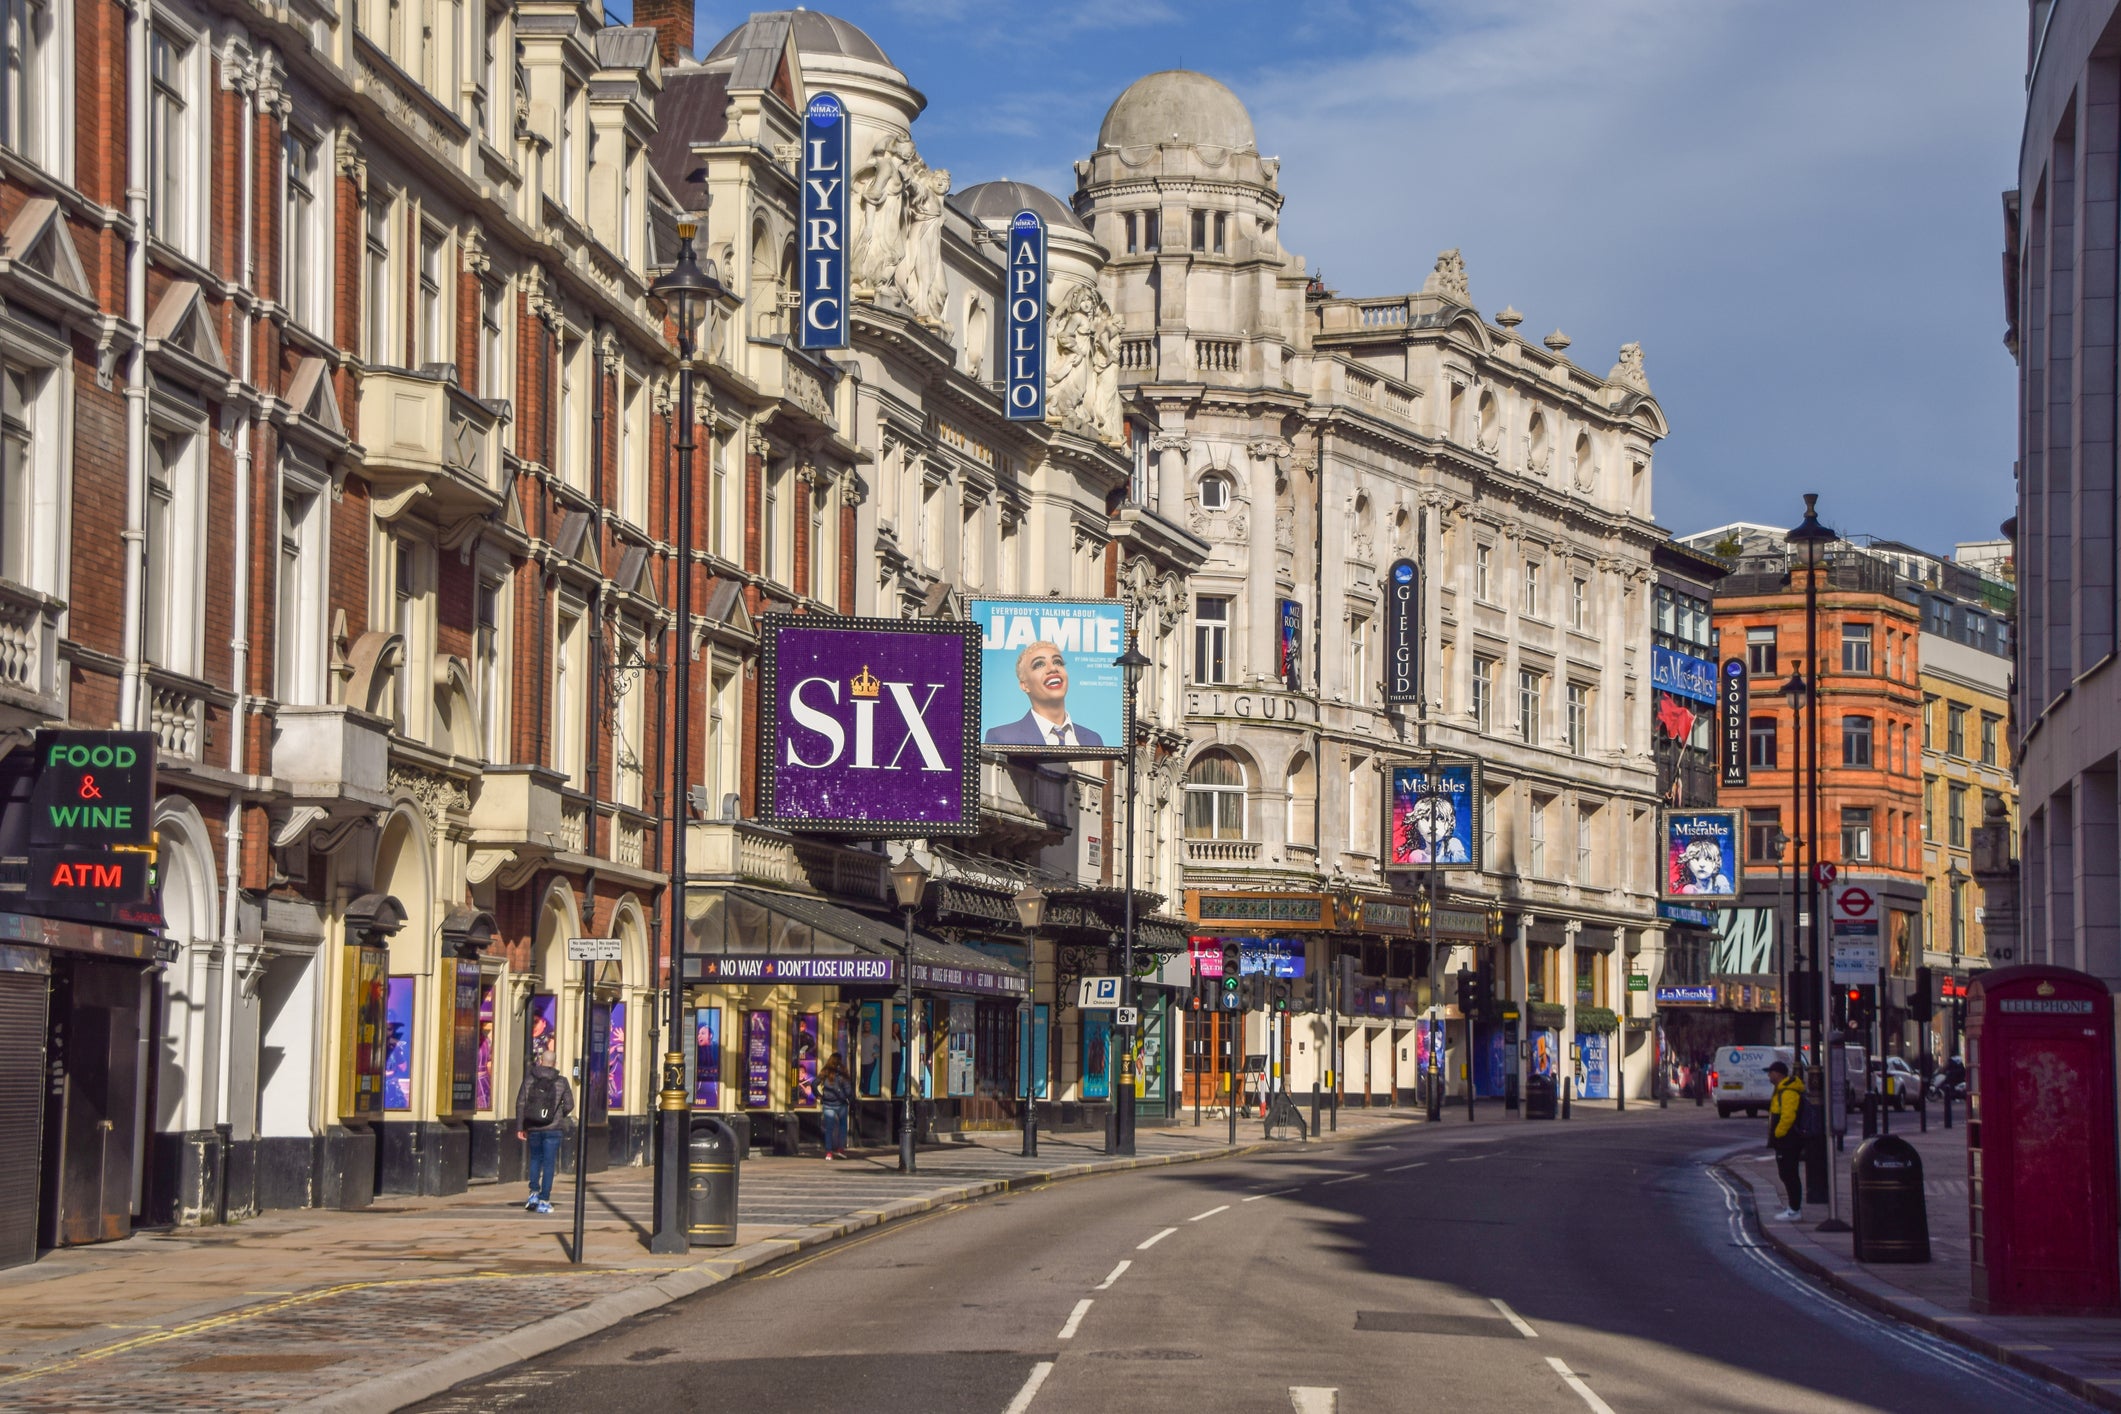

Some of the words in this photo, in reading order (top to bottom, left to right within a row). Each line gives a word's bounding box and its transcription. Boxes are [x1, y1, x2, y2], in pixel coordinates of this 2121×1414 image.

[807, 140, 841, 330] LYRIC
[1011, 241, 1039, 408] APOLLO
[991, 606, 1039, 616] EVERYBODY'S
[1042, 608, 1070, 617] TALKING
[1072, 609, 1096, 618] ABOUT
[982, 615, 1119, 653] JAMIE
[1396, 585, 1410, 693] GIELGUD
[1653, 650, 1668, 684] Les
[1728, 679, 1740, 777] SONDHEIM
[50, 745, 137, 768] FOOD
[80, 775, 102, 798] &
[50, 806, 132, 828] WINE
[1693, 818, 1707, 827] Les
[52, 863, 122, 888] ATM
[1820, 864, 1833, 880] K
[1194, 941, 1219, 959] Les
[1994, 948, 2012, 960] 40
[720, 959, 736, 976] NO
[738, 959, 763, 976] WAY
[778, 960, 810, 977] DON'T
[812, 961, 837, 977] LOSE
[839, 961, 855, 977] UR
[856, 961, 886, 977] HEAD
[1101, 981, 1112, 996] P
[1661, 988, 1675, 998] Les
[2005, 1001, 2092, 1011] TELEPHONE
